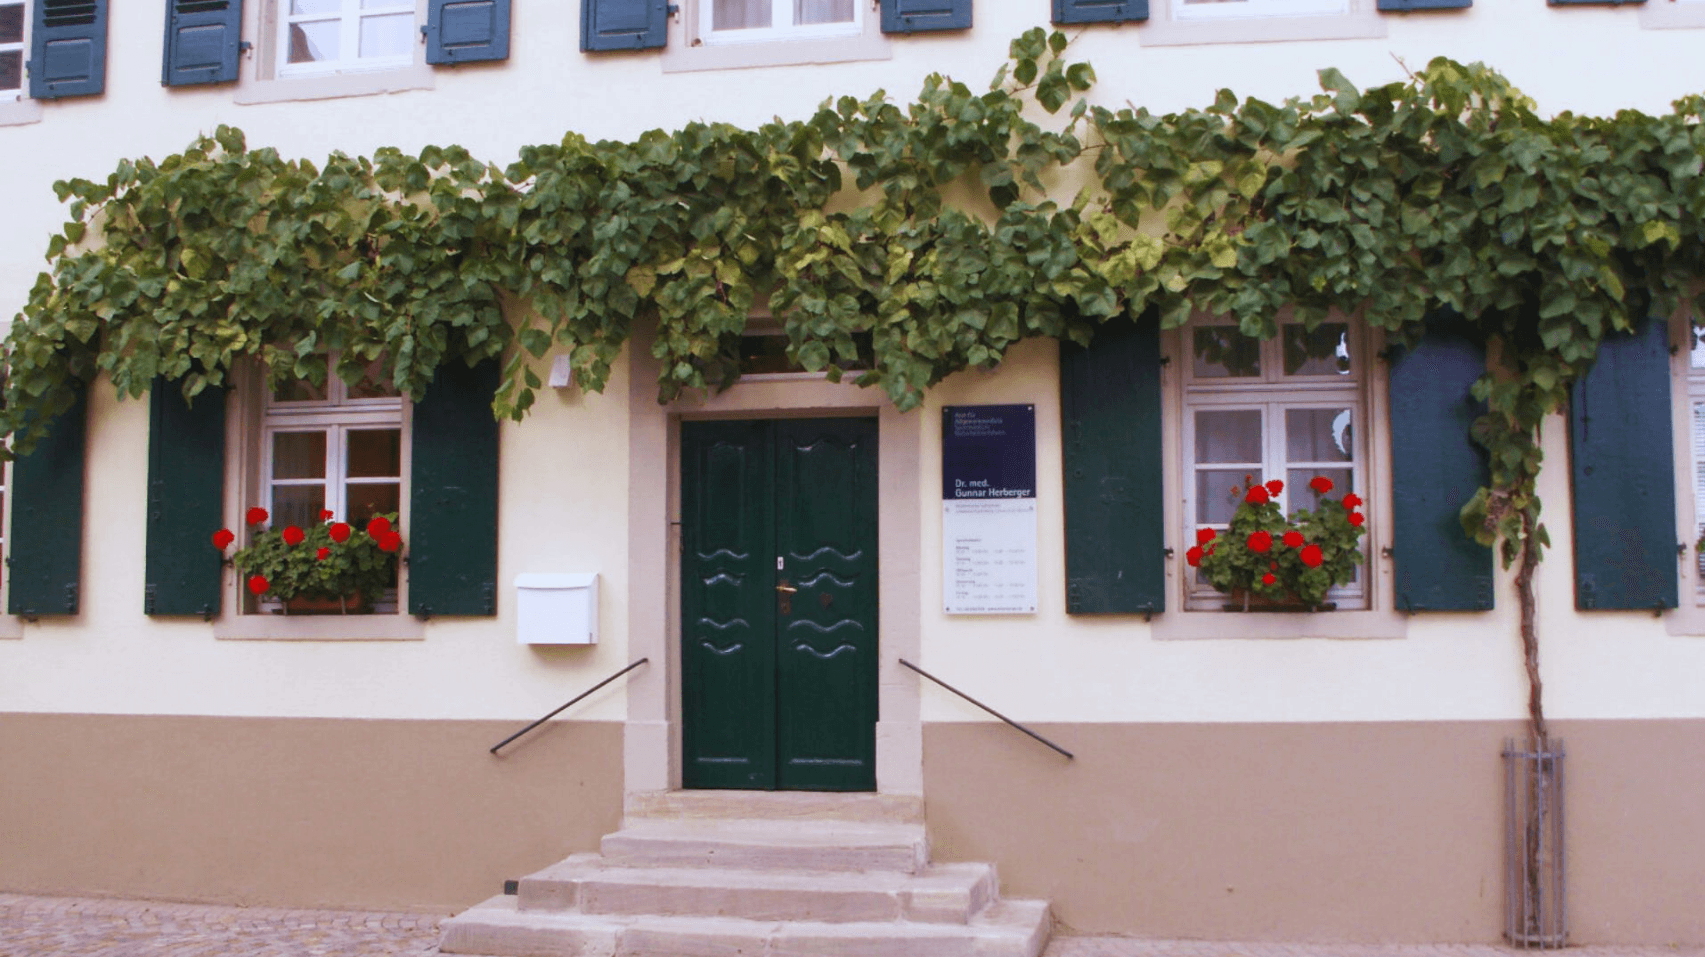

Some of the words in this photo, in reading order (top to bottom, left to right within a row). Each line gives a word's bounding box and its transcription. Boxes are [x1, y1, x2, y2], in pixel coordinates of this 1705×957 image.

[955, 479, 967, 488] Dr.
[969, 479, 990, 488] med.
[955, 488, 986, 498] Gunnar
[988, 487, 1031, 499] Herberger
